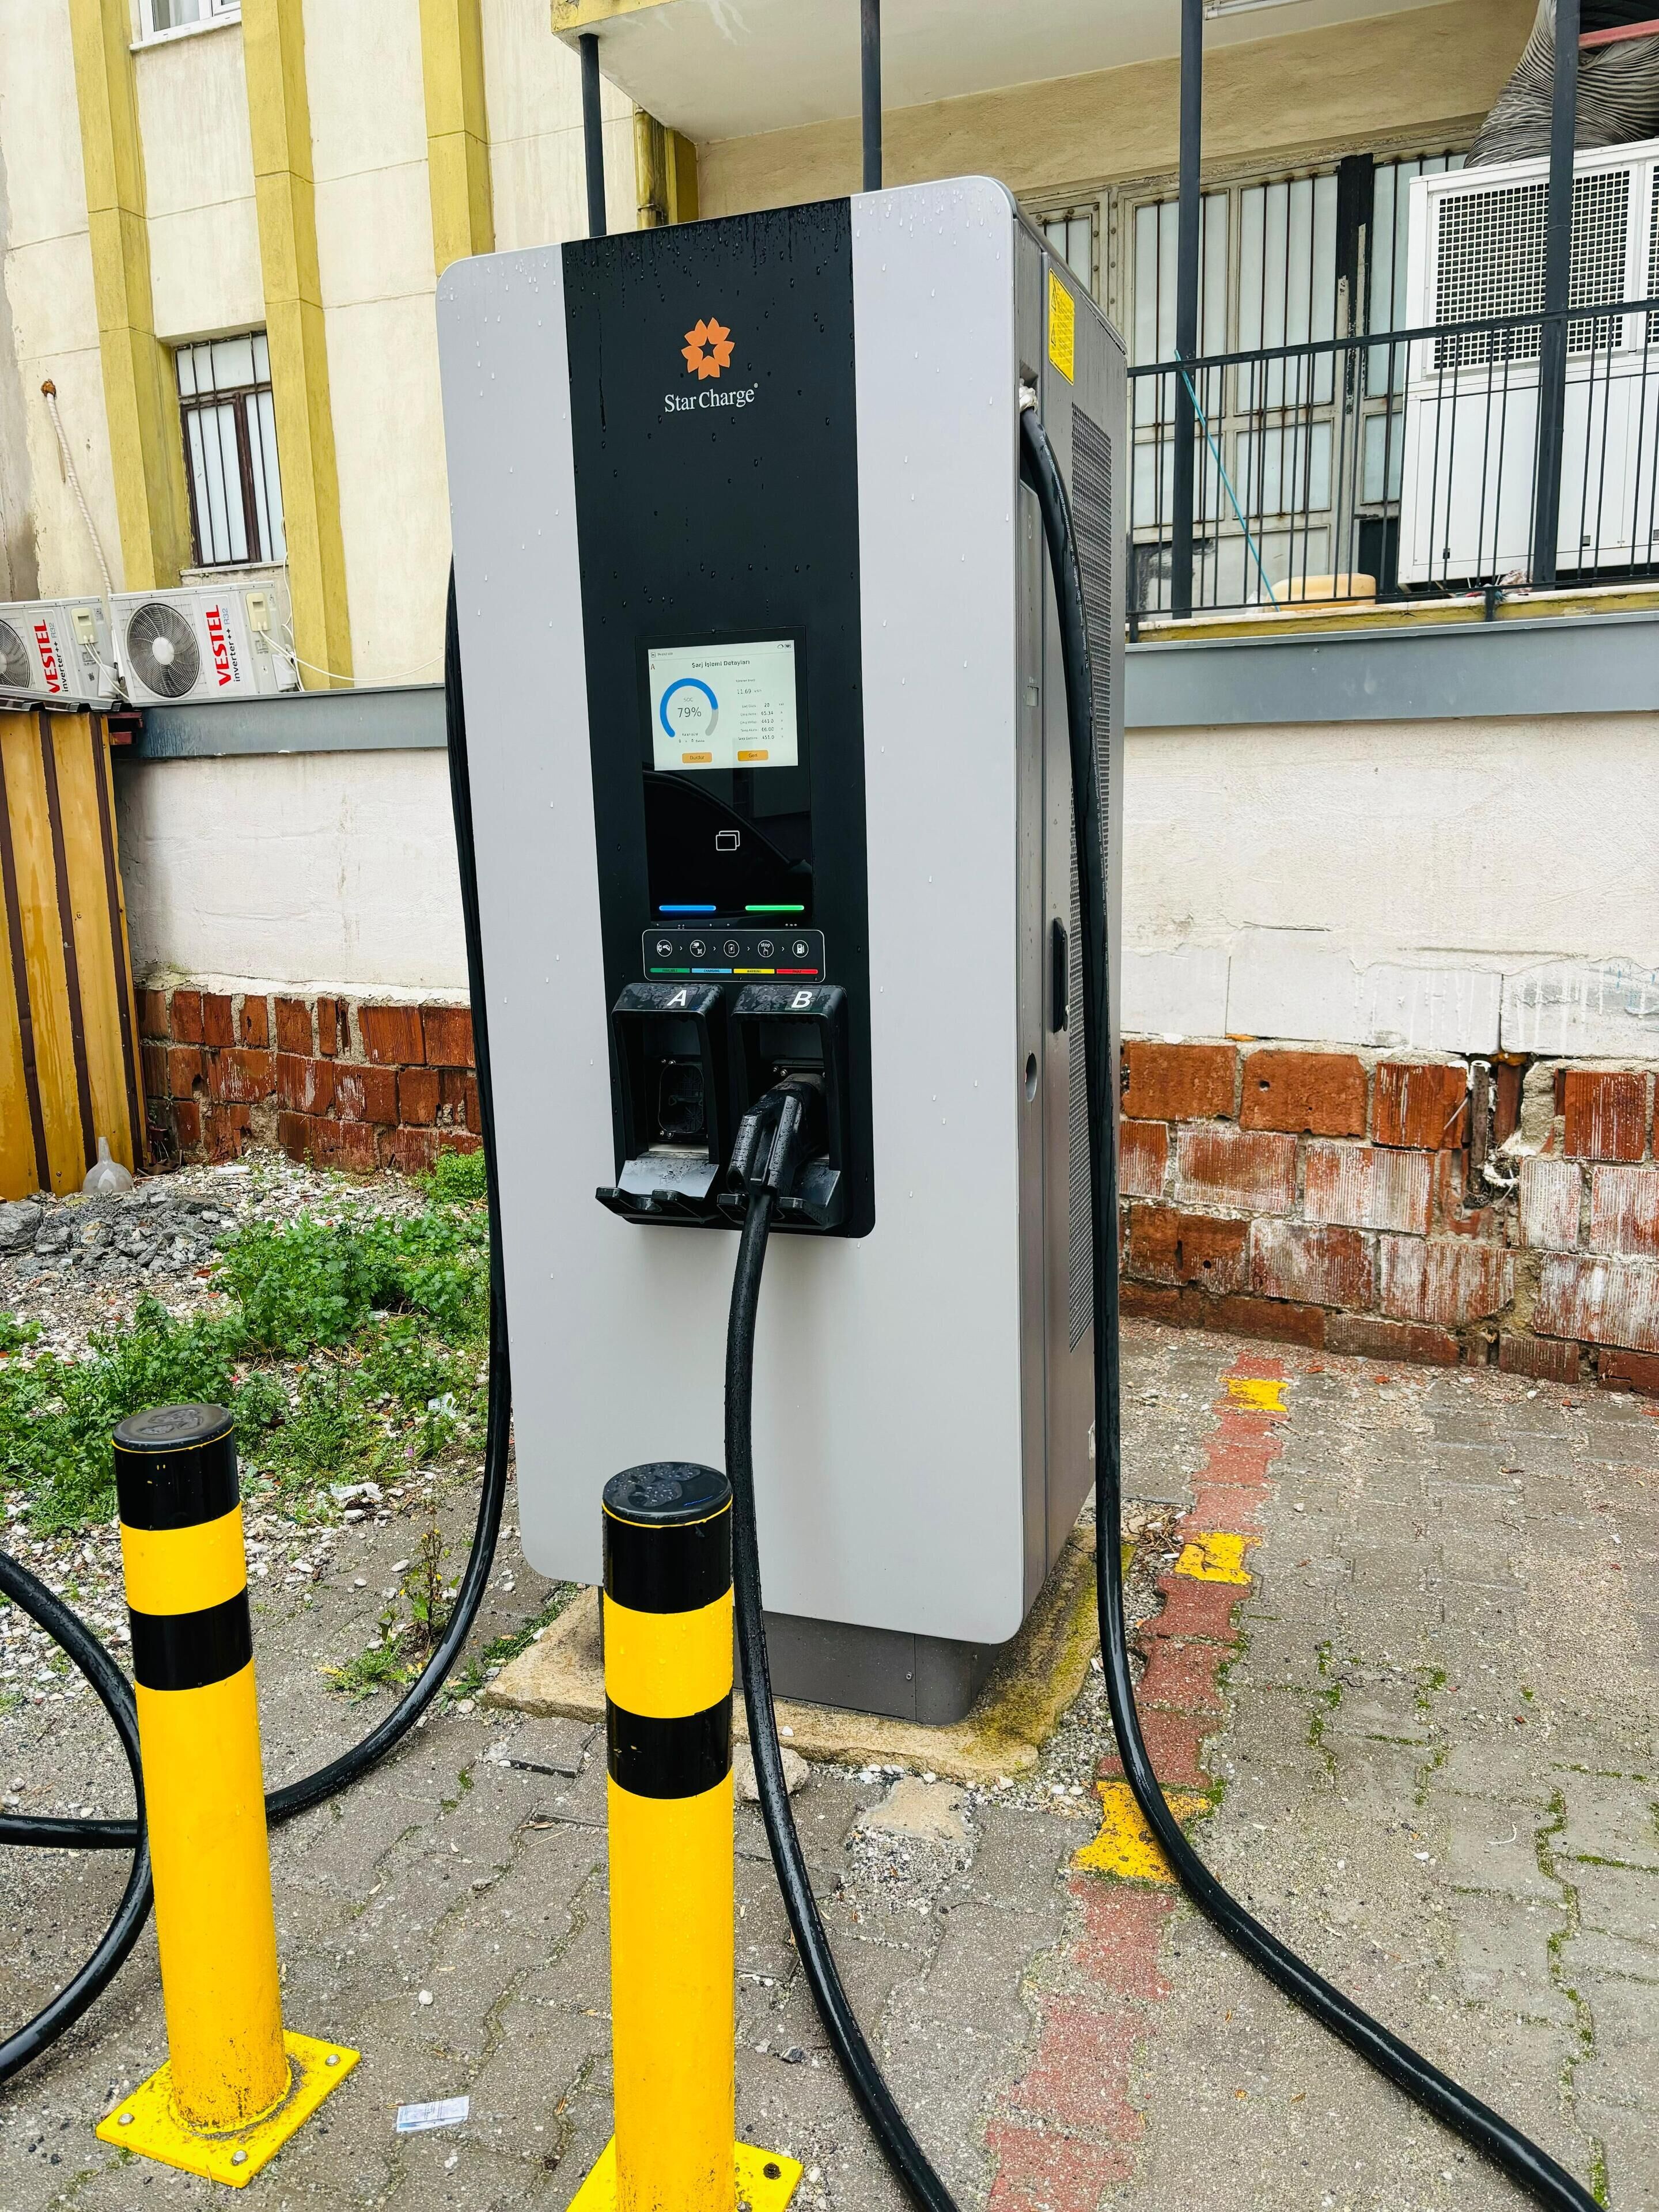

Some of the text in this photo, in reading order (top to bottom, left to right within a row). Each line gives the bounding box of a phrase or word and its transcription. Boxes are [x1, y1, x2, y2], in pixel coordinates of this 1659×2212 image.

[665, 393, 696, 412] Star
[33, 619, 60, 694] VESTEL
[48, 622, 69, 692] inverter++ R32
[206, 604, 232, 687] VESTEL
[222, 608, 241, 682] inverter++ R32
[677, 707, 702, 718] 79%
[666, 990, 687, 1006] A
[791, 991, 813, 1009] B
